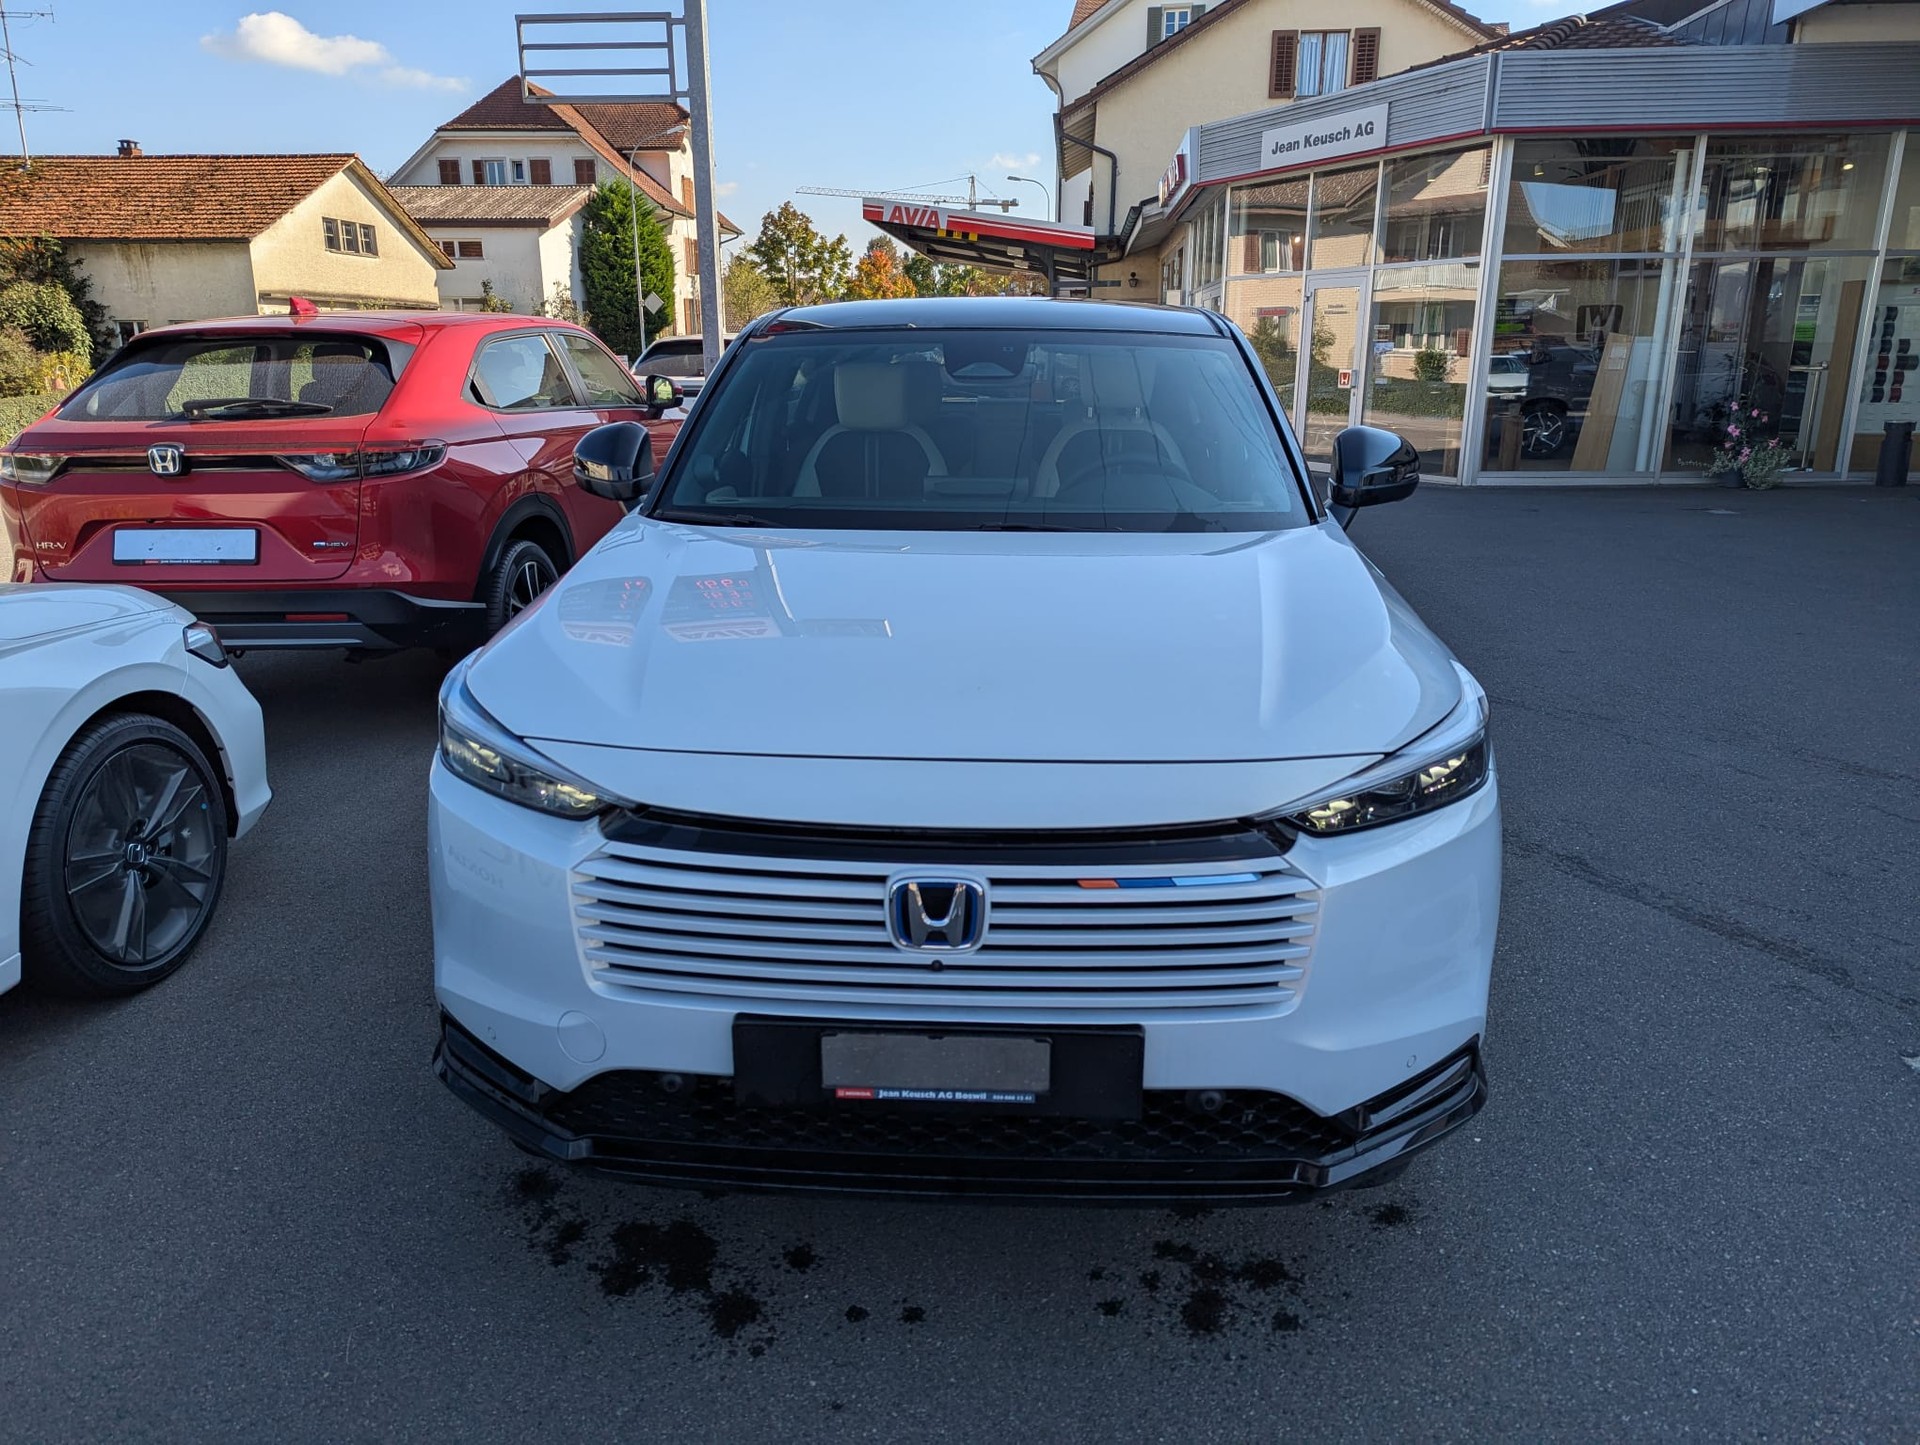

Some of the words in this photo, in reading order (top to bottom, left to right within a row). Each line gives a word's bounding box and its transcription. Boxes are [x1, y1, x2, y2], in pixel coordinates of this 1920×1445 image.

[1271, 141, 1300, 155] Jean
[1303, 126, 1350, 149] Keusch
[1354, 120, 1375, 138] AG
[888, 204, 940, 229] AVIA
[35, 541, 67, 549] HR-V
[878, 1089, 900, 1099] Jean
[901, 1090, 936, 1099] Keusch
[937, 1091, 953, 1099] AG
